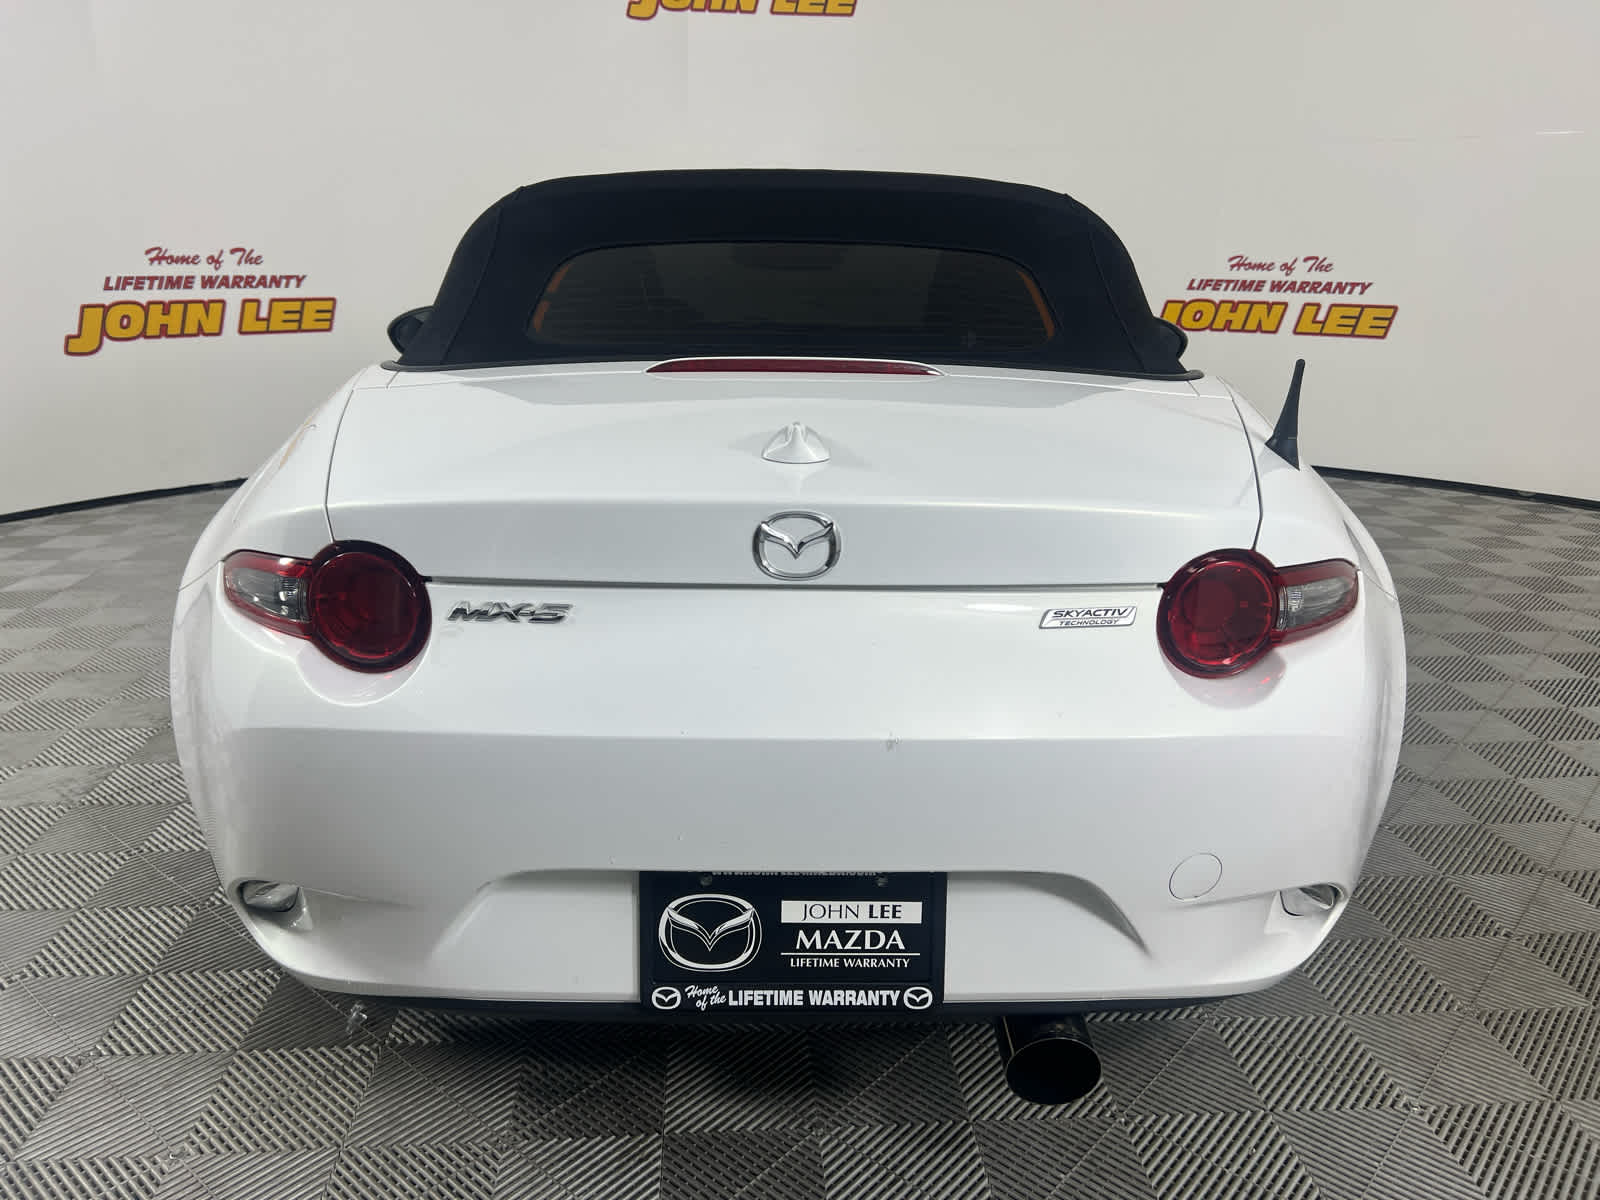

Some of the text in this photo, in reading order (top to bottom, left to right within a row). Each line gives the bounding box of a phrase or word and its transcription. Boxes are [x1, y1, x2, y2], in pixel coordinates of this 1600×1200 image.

[145, 246, 263, 270] Home of The
[1228, 254, 1334, 276] Home of The
[103, 274, 306, 291] LIFETIME WARRANTY
[1187, 278, 1372, 295] LIFETIME WARRANTY
[64, 297, 336, 356] JOHN LEE
[1293, 303, 1398, 339] LEE
[448, 601, 573, 624] MX-5
[1053, 609, 1128, 617] SKYACTIV
[801, 904, 902, 921] JOHN LEE
[796, 929, 906, 950] MAZDA
[790, 958, 910, 968] LIFETIME WARRANTY
[685, 985, 718, 998] Home
[729, 990, 901, 1006] LIFETIME WARRANTY
[696, 991, 727, 1011] of the
